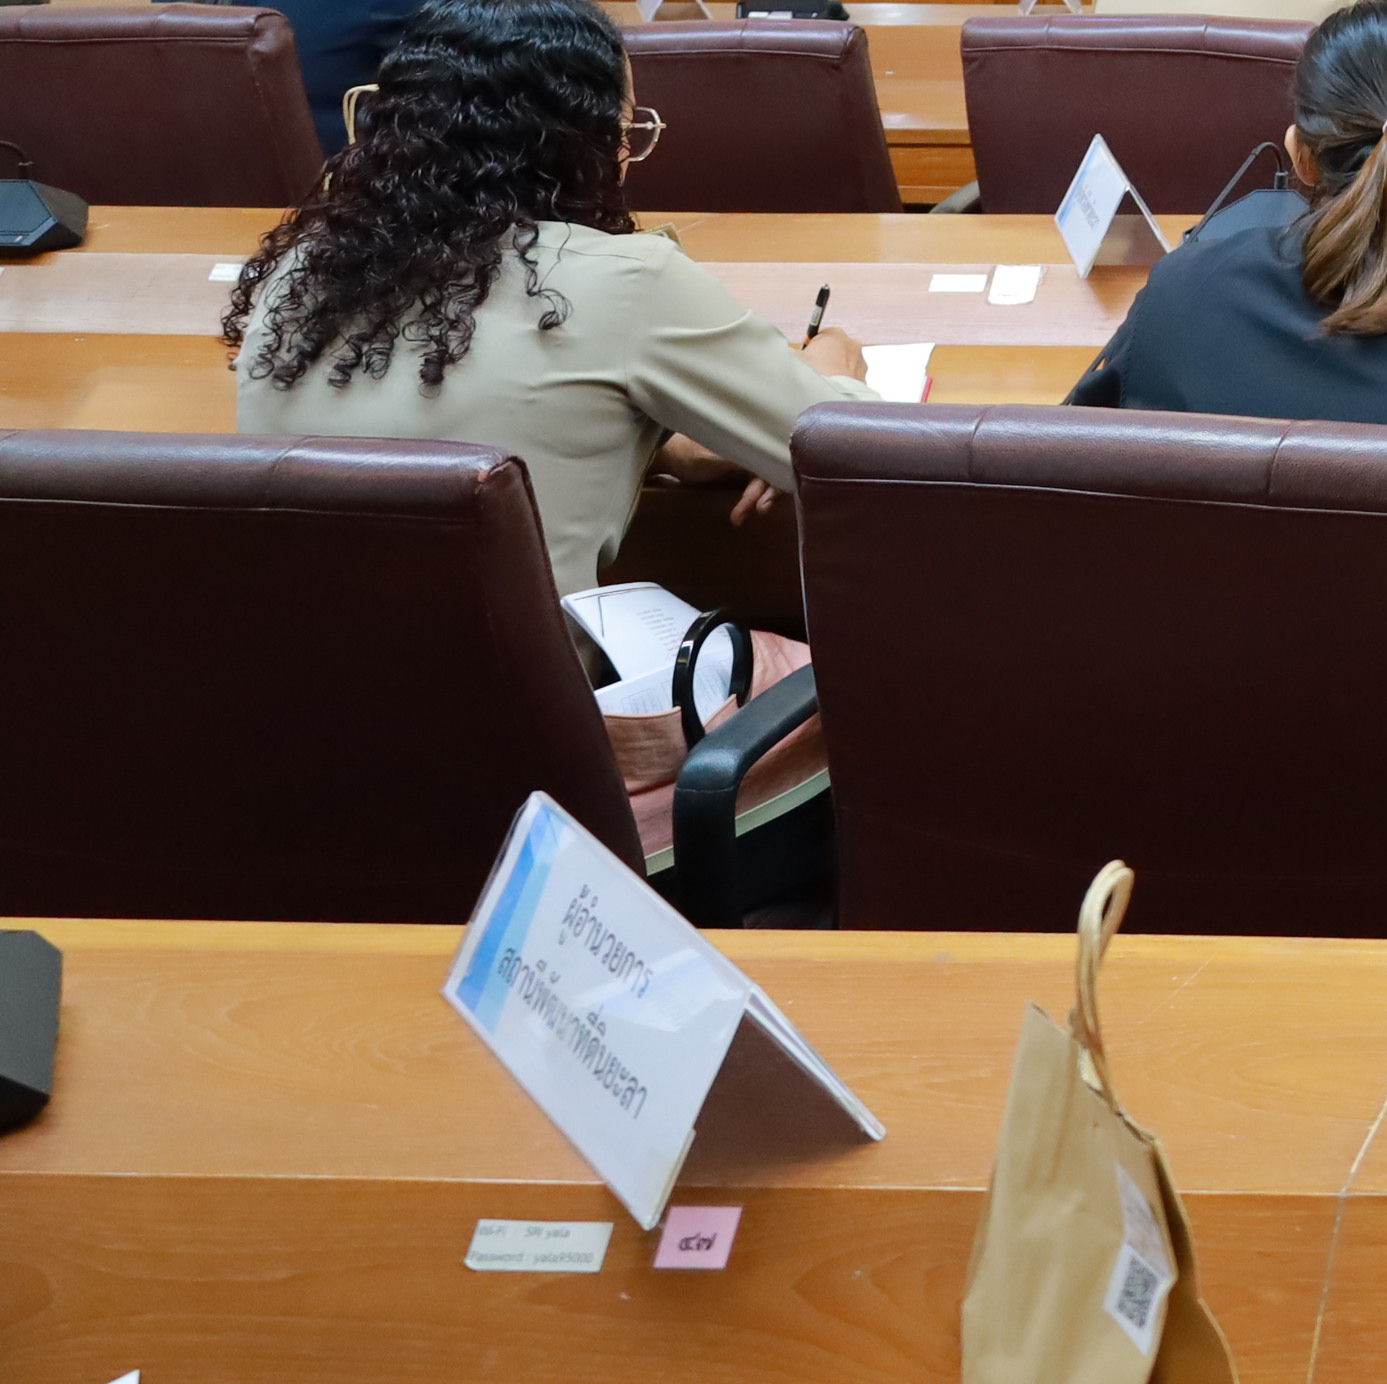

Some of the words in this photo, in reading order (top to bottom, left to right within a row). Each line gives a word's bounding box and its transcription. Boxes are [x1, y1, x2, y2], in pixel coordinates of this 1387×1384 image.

[558, 884, 653, 999] ผู้อำนวยการ
[497, 947, 648, 1119] สถานีพัฒนาที่ดินยะลา
